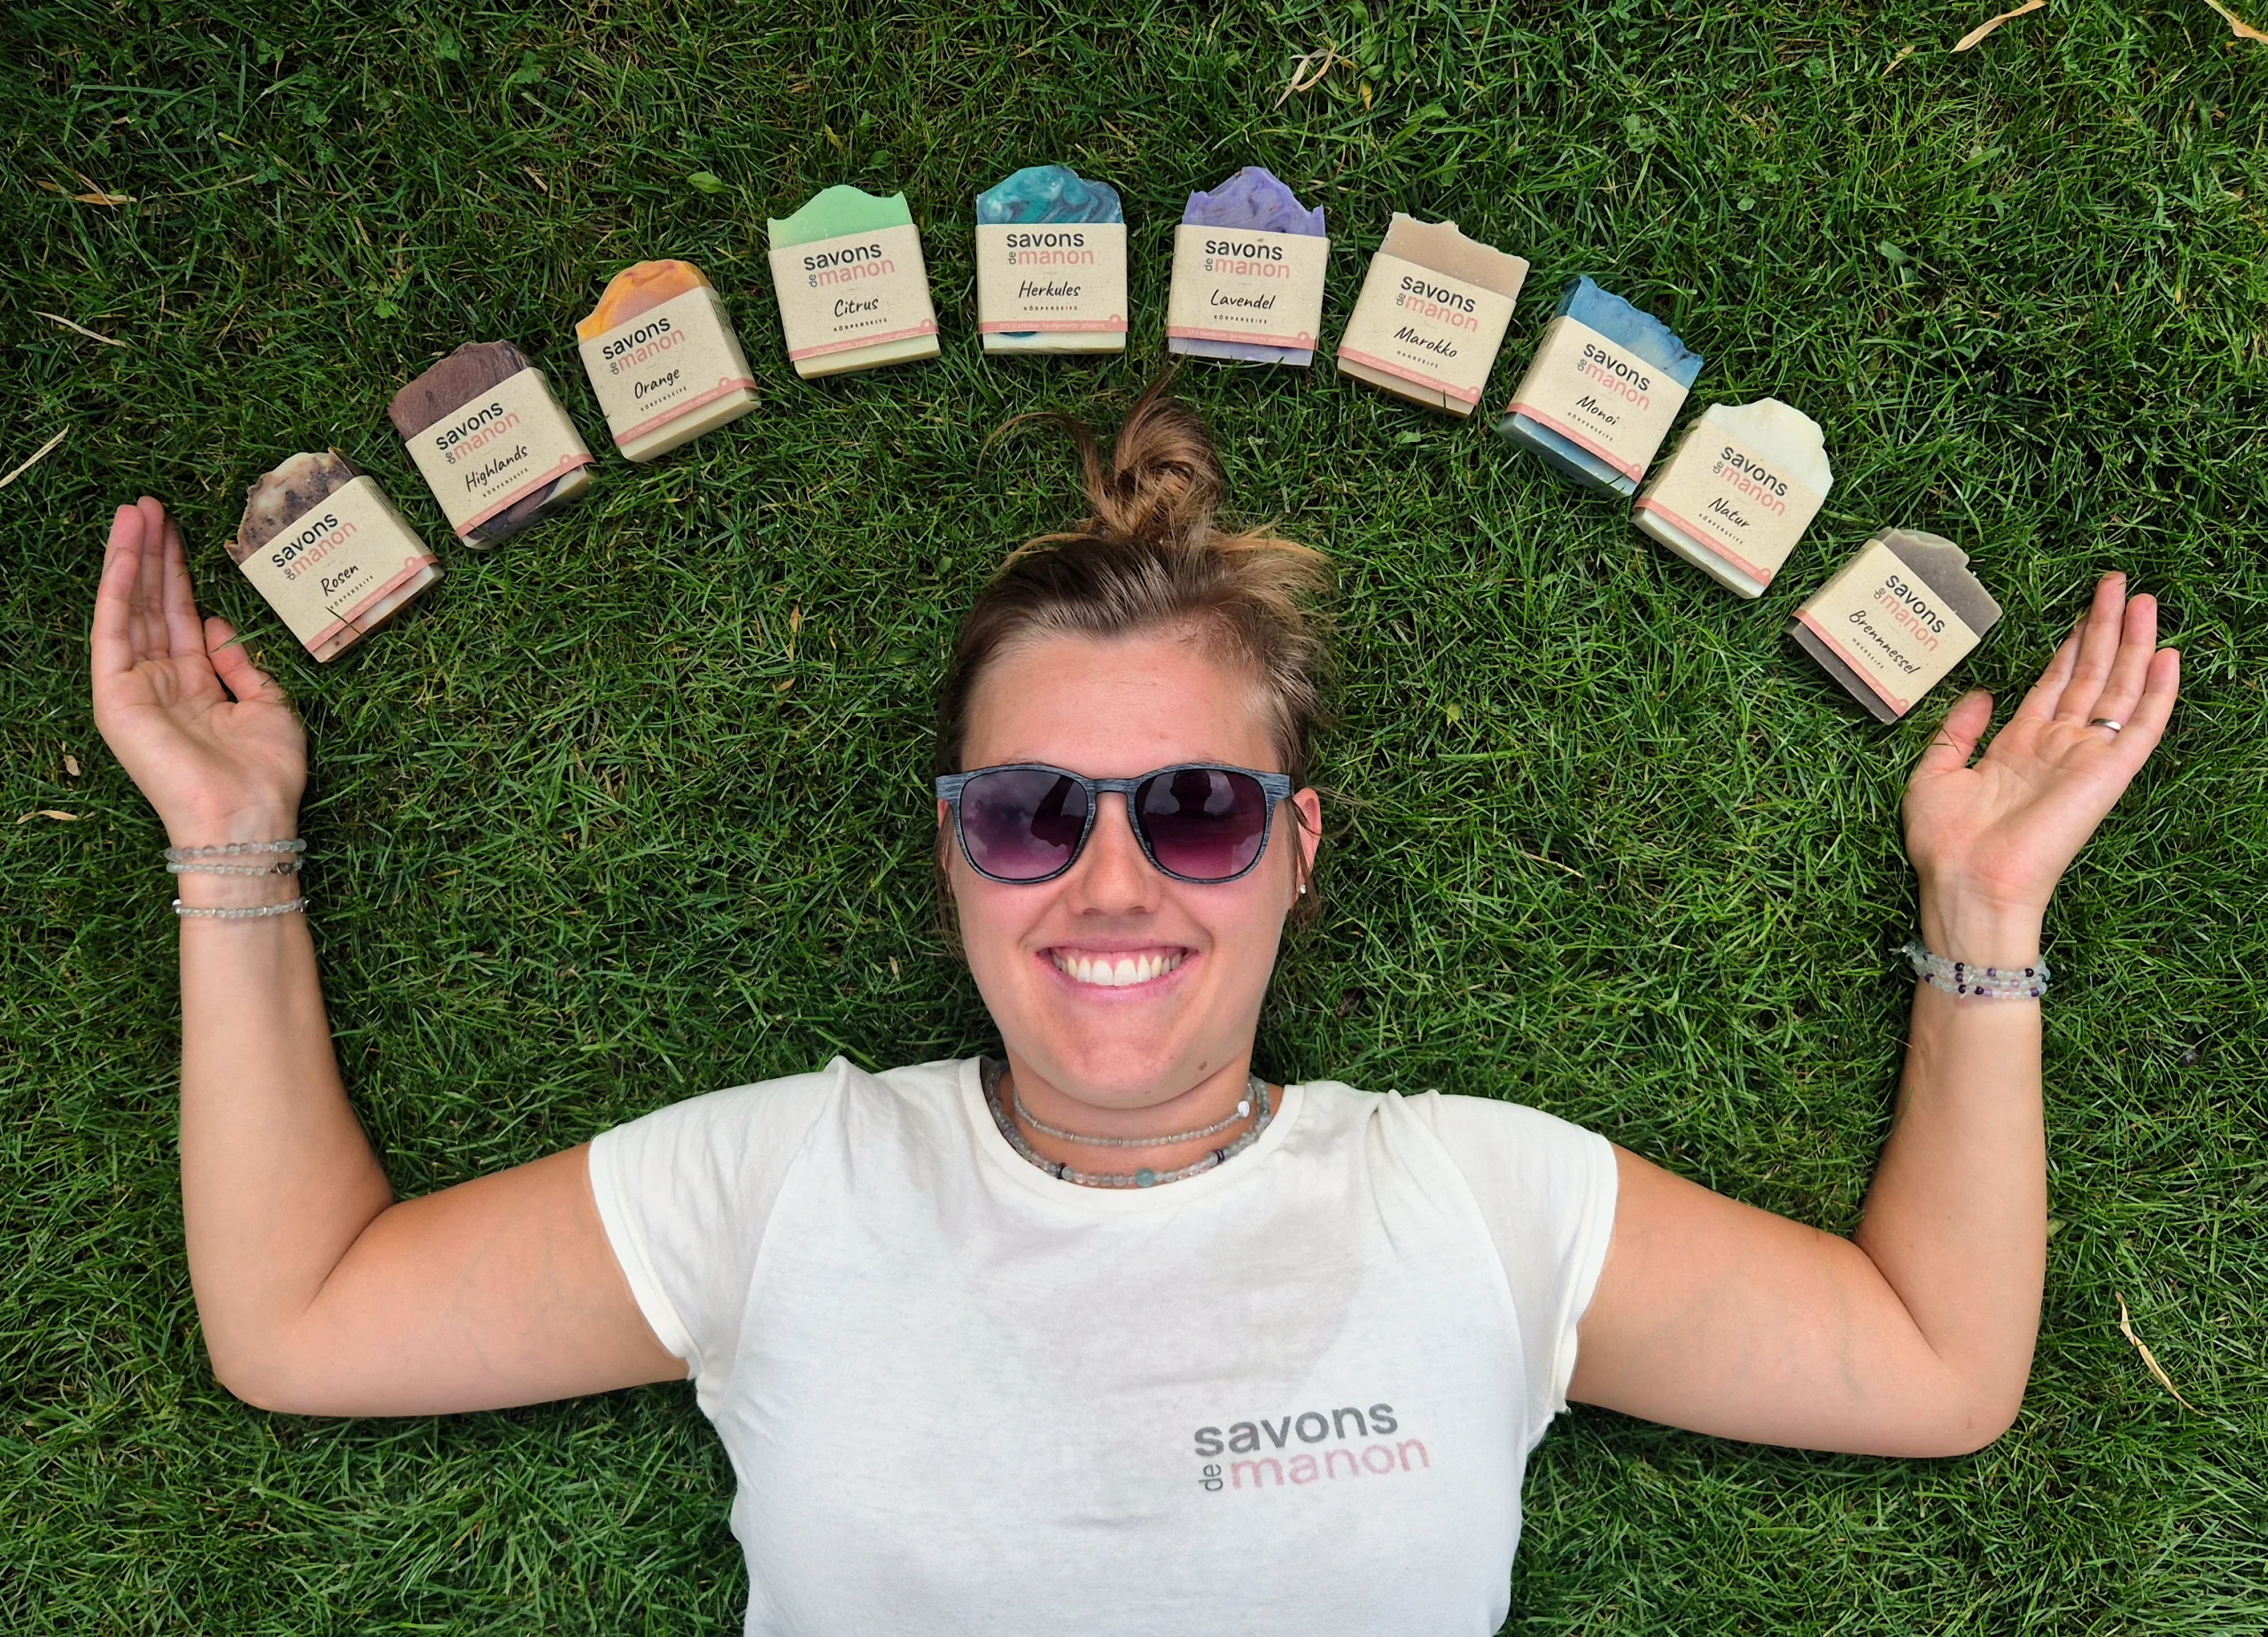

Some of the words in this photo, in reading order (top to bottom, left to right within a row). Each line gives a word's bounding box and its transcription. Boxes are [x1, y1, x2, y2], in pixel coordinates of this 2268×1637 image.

[804, 244, 882, 271] savons
[1006, 233, 1084, 248] savons
[1007, 252, 1016, 265] de
[1019, 250, 1094, 265] manon
[1205, 240, 1284, 260] savons
[809, 274, 817, 288] de
[819, 259, 896, 287] manon
[1204, 258, 1213, 271] de
[1215, 258, 1290, 279] manon
[834, 299, 879, 318] Citrus
[1018, 280, 1081, 299] Herkules
[1210, 289, 1276, 310] Lavendel
[1401, 275, 1477, 313] savons
[1395, 292, 1406, 306] de
[1405, 295, 1479, 332] manon
[602, 317, 671, 360] savons
[610, 361, 620, 376] de
[617, 329, 687, 372] manon
[1394, 326, 1457, 358] Marokko
[634, 369, 680, 399] Orange
[1577, 360, 1587, 371] de
[1585, 364, 1651, 411] manon
[1583, 343, 1651, 391] savons
[436, 402, 504, 451] savons
[1576, 395, 1619, 426] Monoi
[446, 452, 455, 464] de
[454, 412, 521, 461] manon
[465, 445, 528, 492] Highlands
[1713, 461, 1724, 474] de
[1721, 467, 1786, 517] manon
[1721, 446, 1788, 497] savons
[1708, 498, 1751, 528] Natur
[272, 514, 338, 568] savons
[284, 568, 296, 580] de
[291, 522, 358, 575] manon
[321, 563, 360, 597] Rosen
[1874, 587, 1886, 600] de
[1880, 594, 1940, 653] manon
[1885, 575, 1946, 633] savons
[1849, 609, 1922, 675] Brennnessel
[1194, 1403, 1398, 1457] savons
[1199, 1464, 1223, 1492] de
[1230, 1438, 1431, 1490] manon
